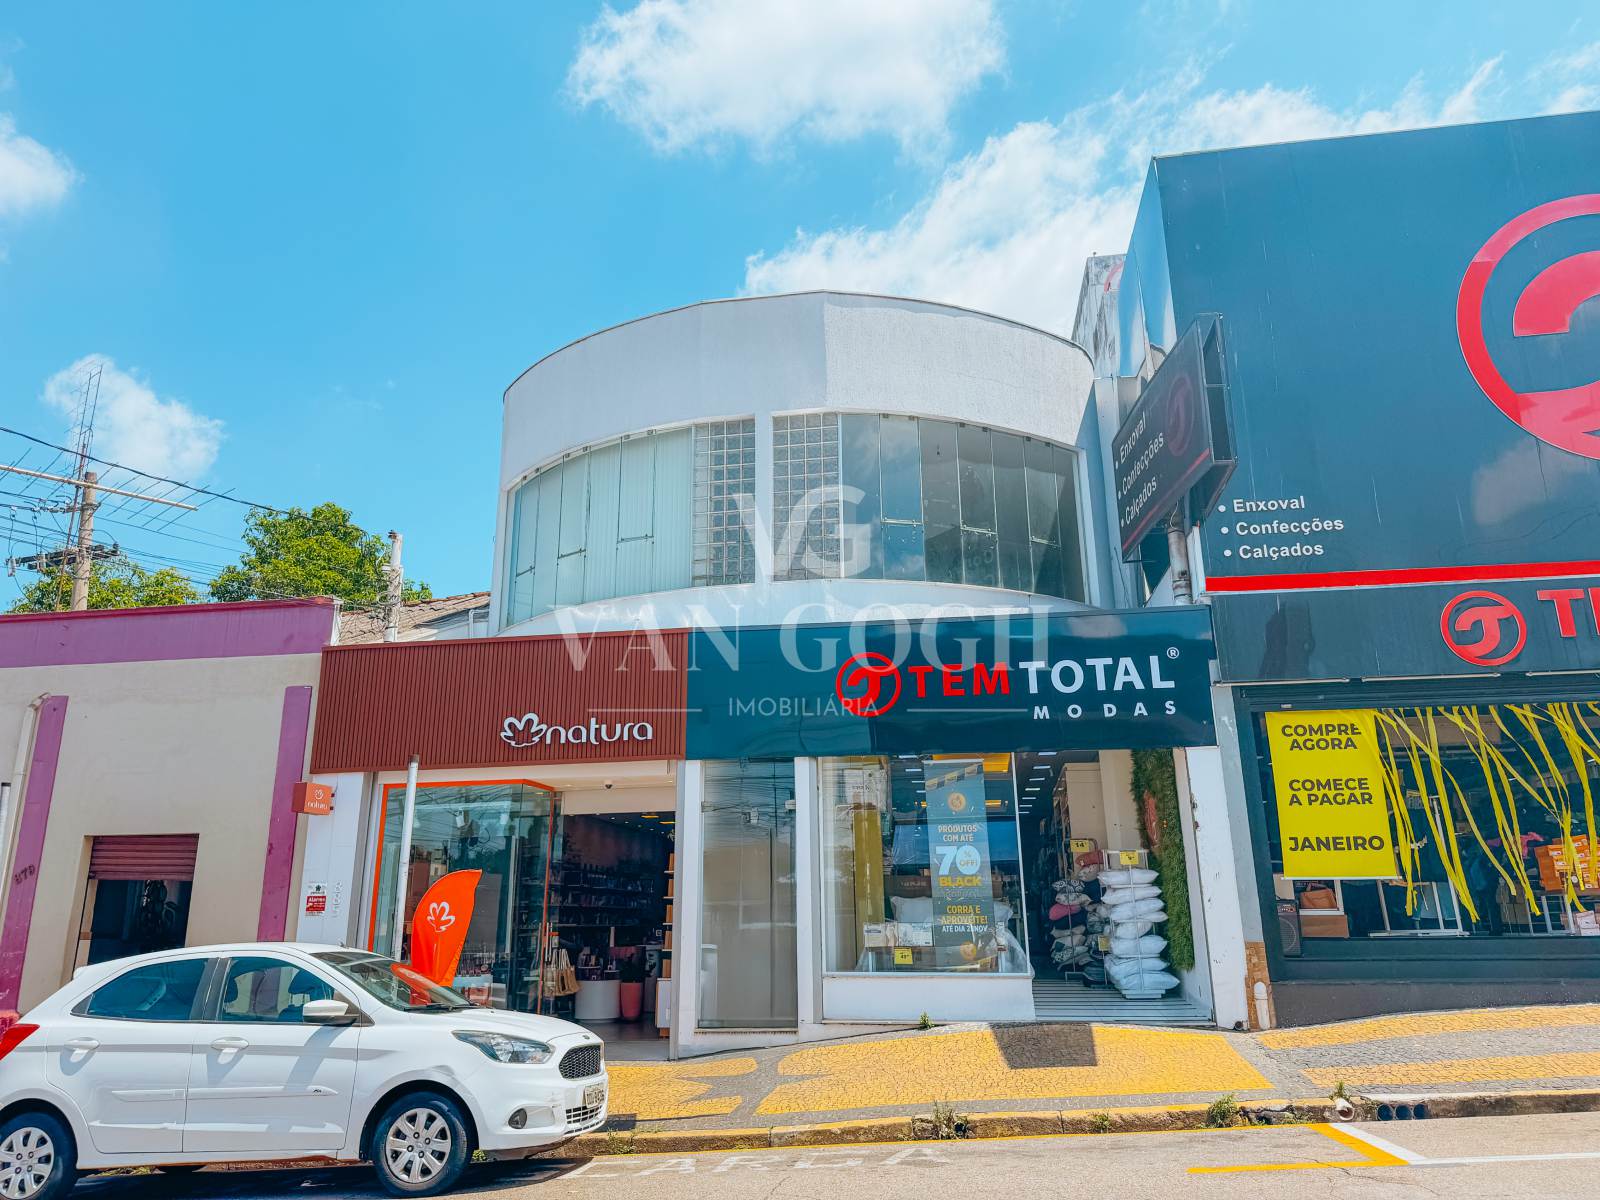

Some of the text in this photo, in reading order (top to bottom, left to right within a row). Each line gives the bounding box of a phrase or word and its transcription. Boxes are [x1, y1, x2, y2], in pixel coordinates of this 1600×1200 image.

[1119, 411, 1147, 465] Enxoval
[1122, 432, 1165, 495] Confecções
[1125, 475, 1158, 525] Calçados
[1232, 495, 1306, 513] Enxoval
[1235, 517, 1345, 535] Confecções
[1238, 542, 1325, 561] Calçados
[908, 661, 1011, 698] TEM
[1033, 700, 1177, 720] MODAS
[545, 717, 653, 745] natura
[1281, 723, 1362, 738] COMPRE
[1289, 737, 1358, 751] AGORA
[1288, 777, 1370, 792] COMECE
[1288, 792, 1374, 806] A PAGAR
[938, 824, 978, 833] PRODUTOS
[943, 833, 975, 843] COM ATÉ
[1288, 835, 1385, 852] JANEIRO
[938, 876, 983, 887] BLACK
[946, 905, 974, 914] CORRA
